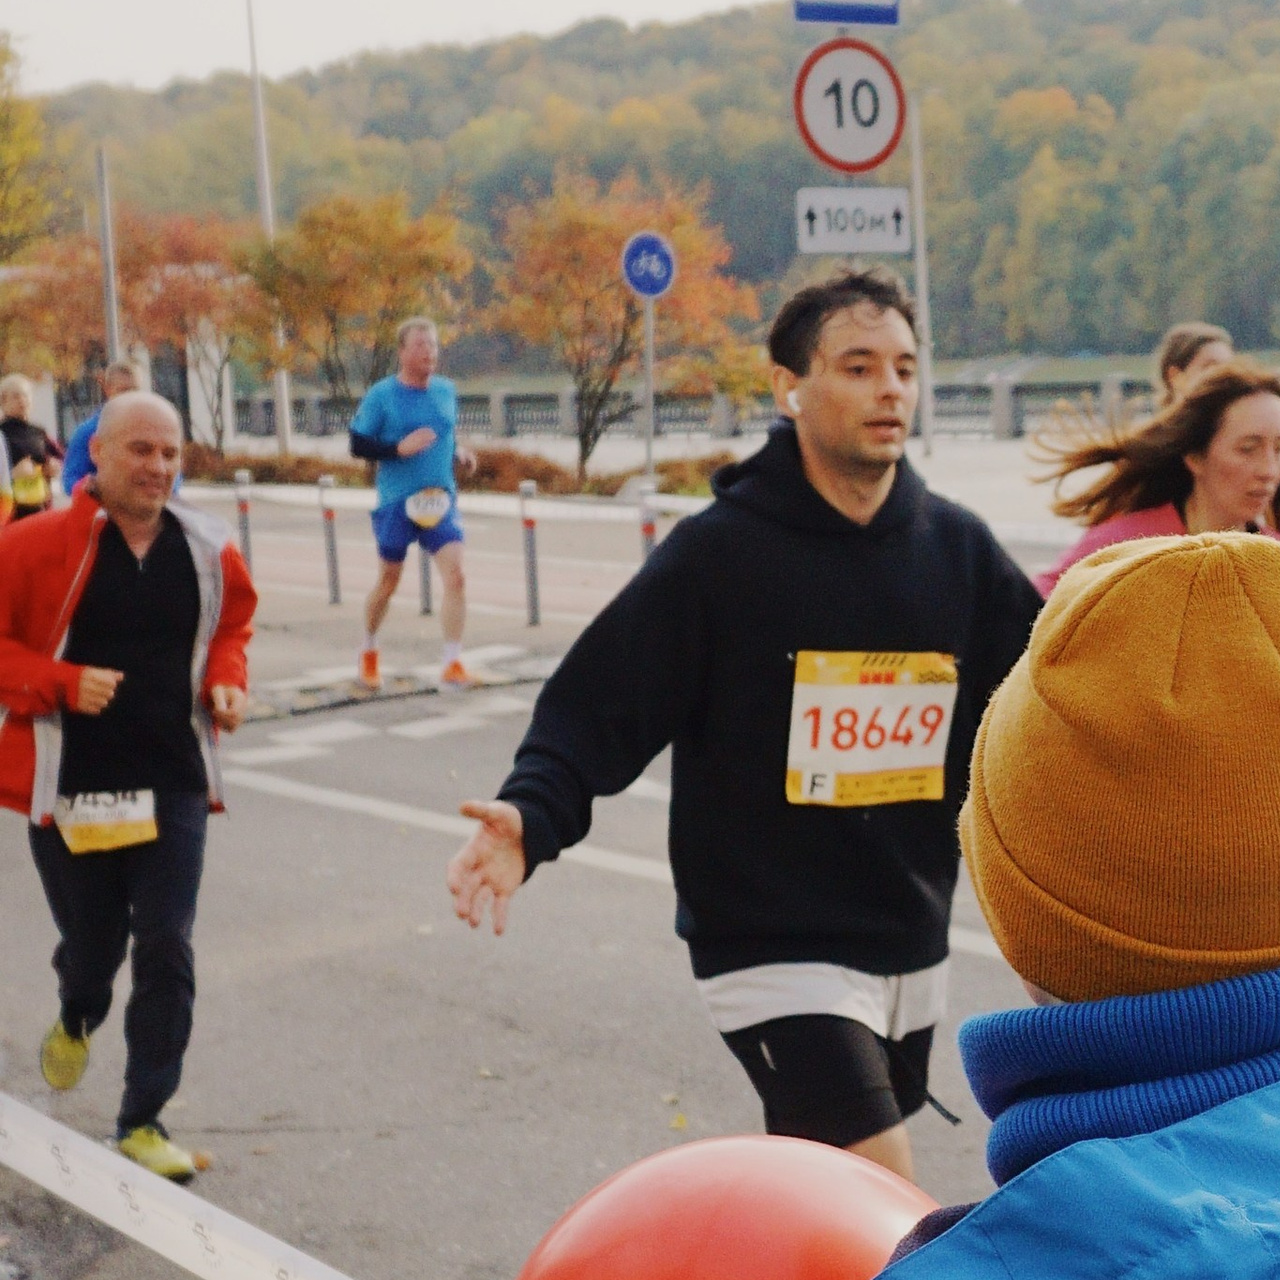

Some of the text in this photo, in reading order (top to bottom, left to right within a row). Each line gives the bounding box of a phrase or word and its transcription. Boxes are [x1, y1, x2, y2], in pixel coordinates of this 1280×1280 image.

[824, 78, 880, 128] 10
[803, 704, 945, 751] 18649
[808, 773, 828, 795] F
